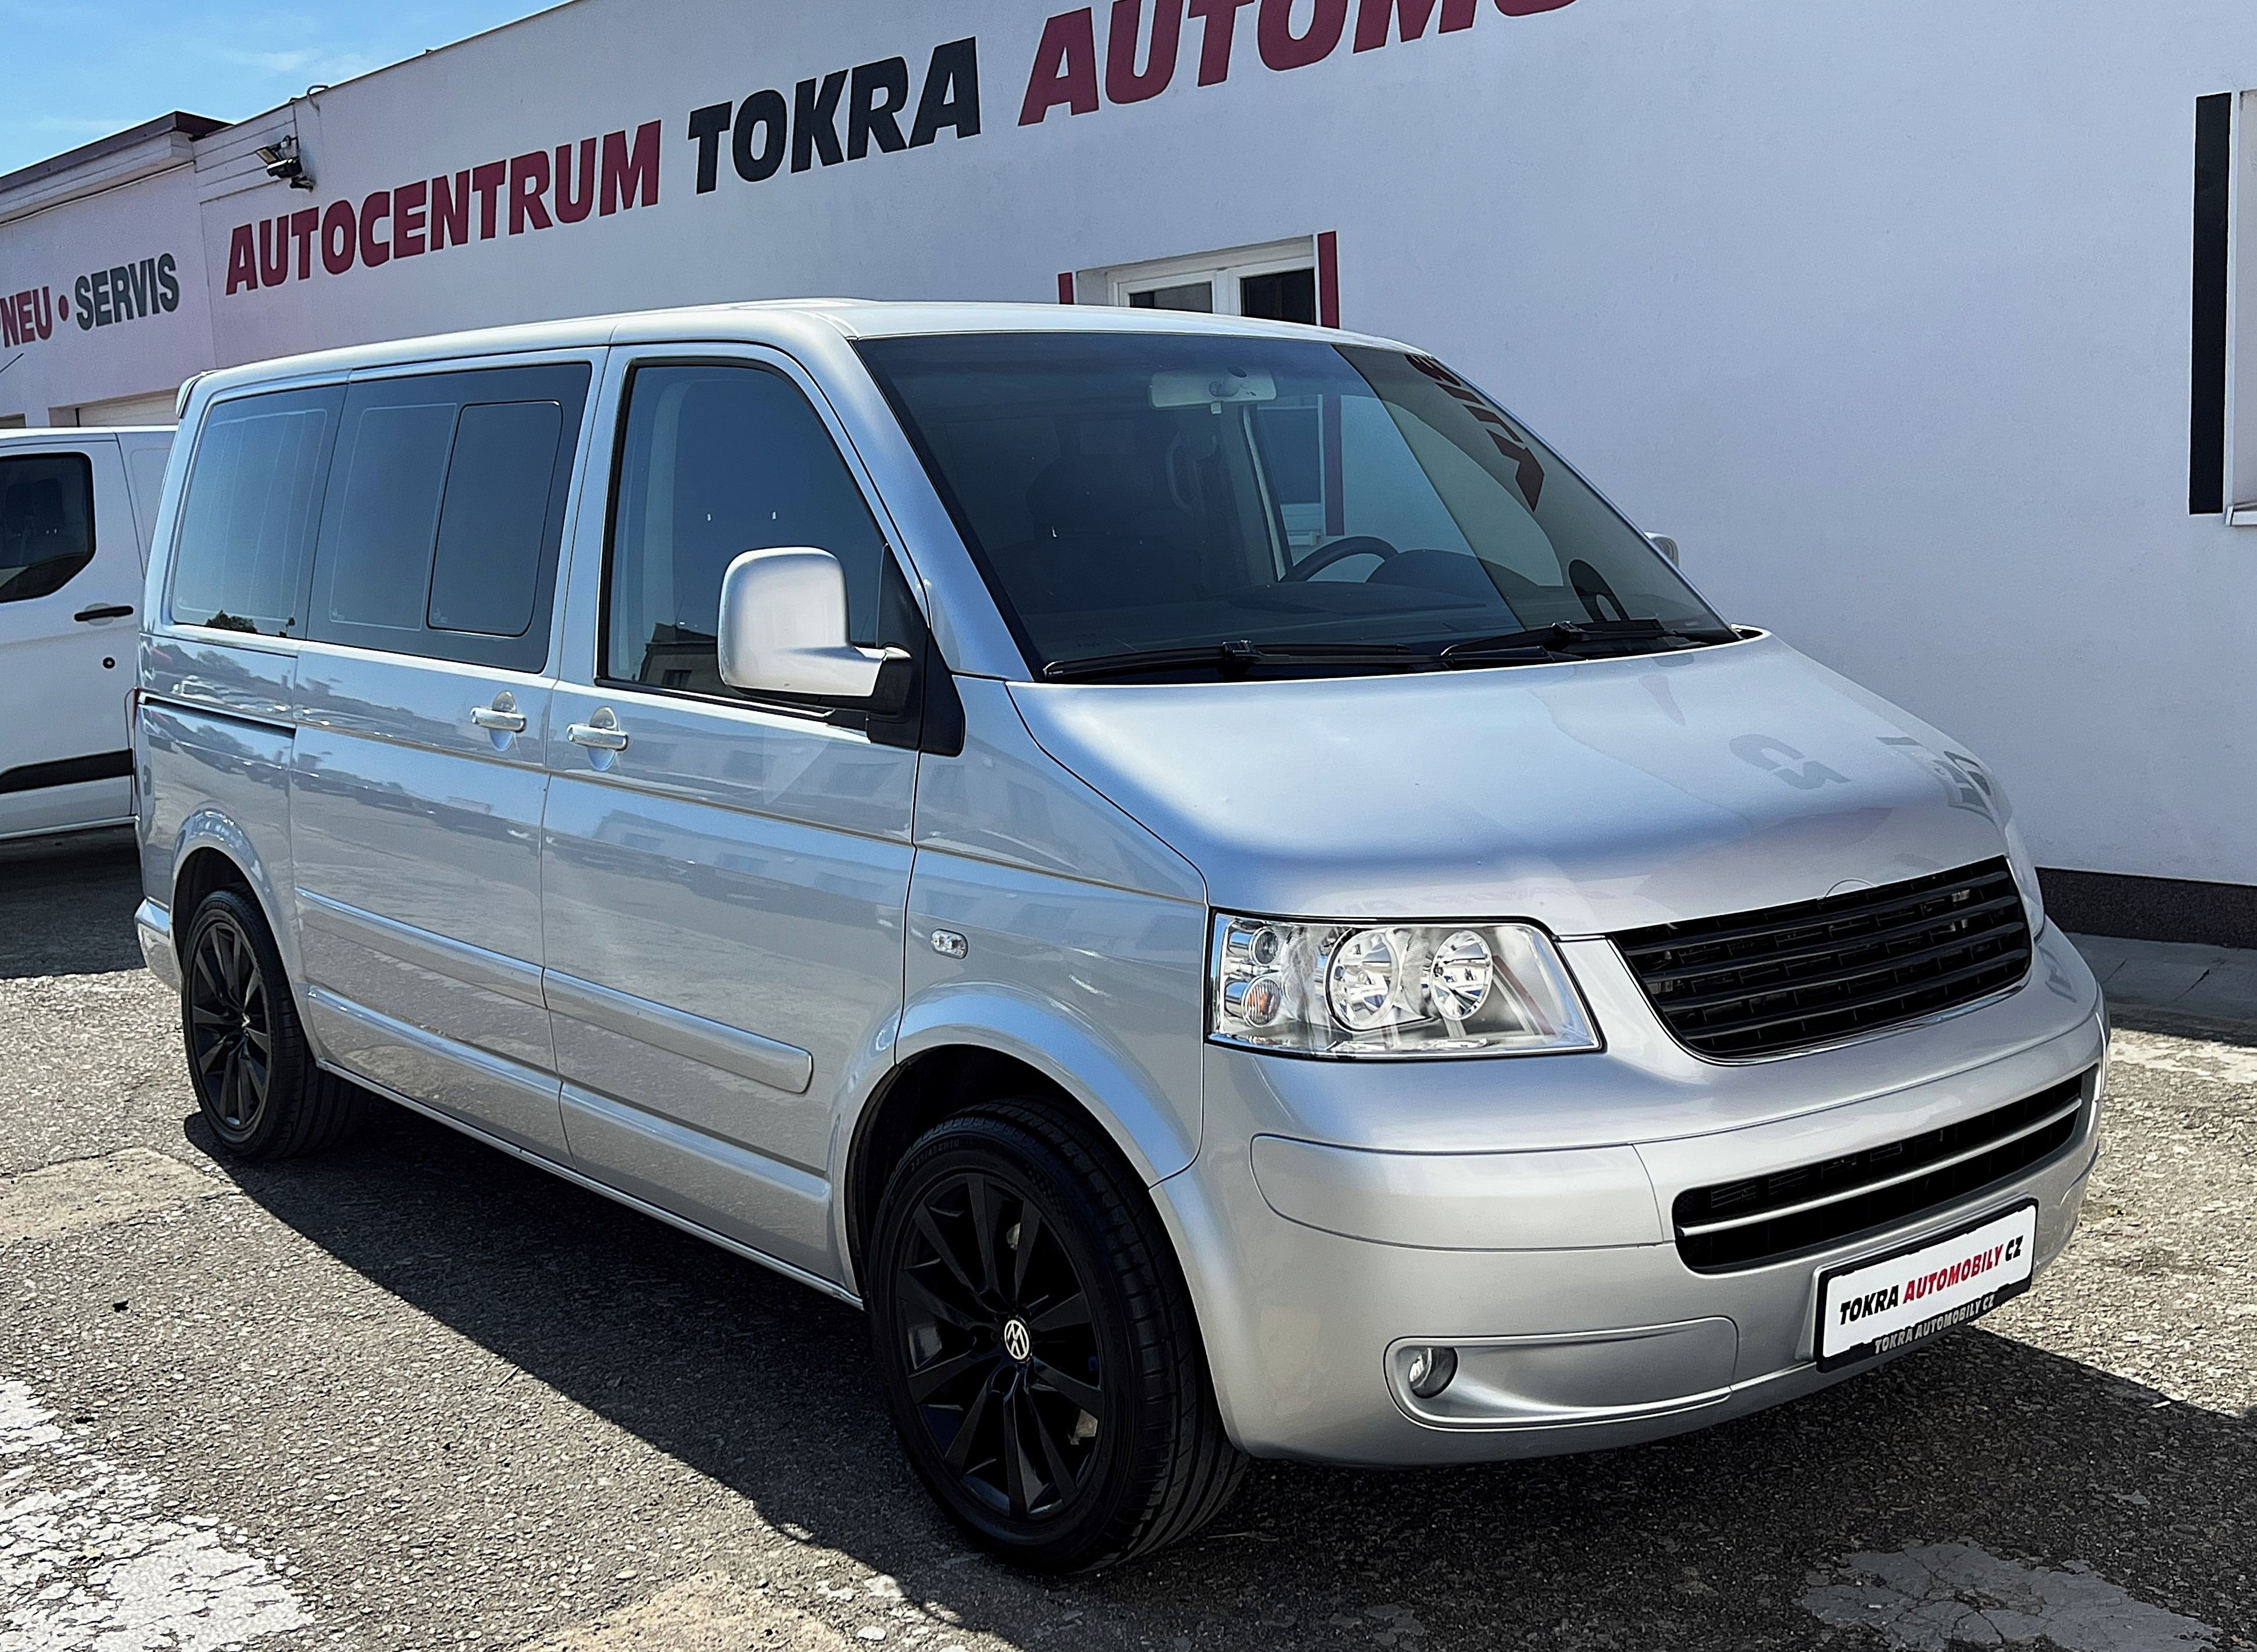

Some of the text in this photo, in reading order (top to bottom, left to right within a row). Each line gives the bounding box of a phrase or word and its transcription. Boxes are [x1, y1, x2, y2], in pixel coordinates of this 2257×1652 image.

[225, 0, 1576, 296] AUTOCENTRUM TOKRA AUTO
[0, 254, 180, 348] NEU SERVIS
[1840, 1235, 2023, 1325] TOKRA AUTOMOBILY CZ
[1875, 1293, 1995, 1354] TOKRA AUTOMOBILY CZ
